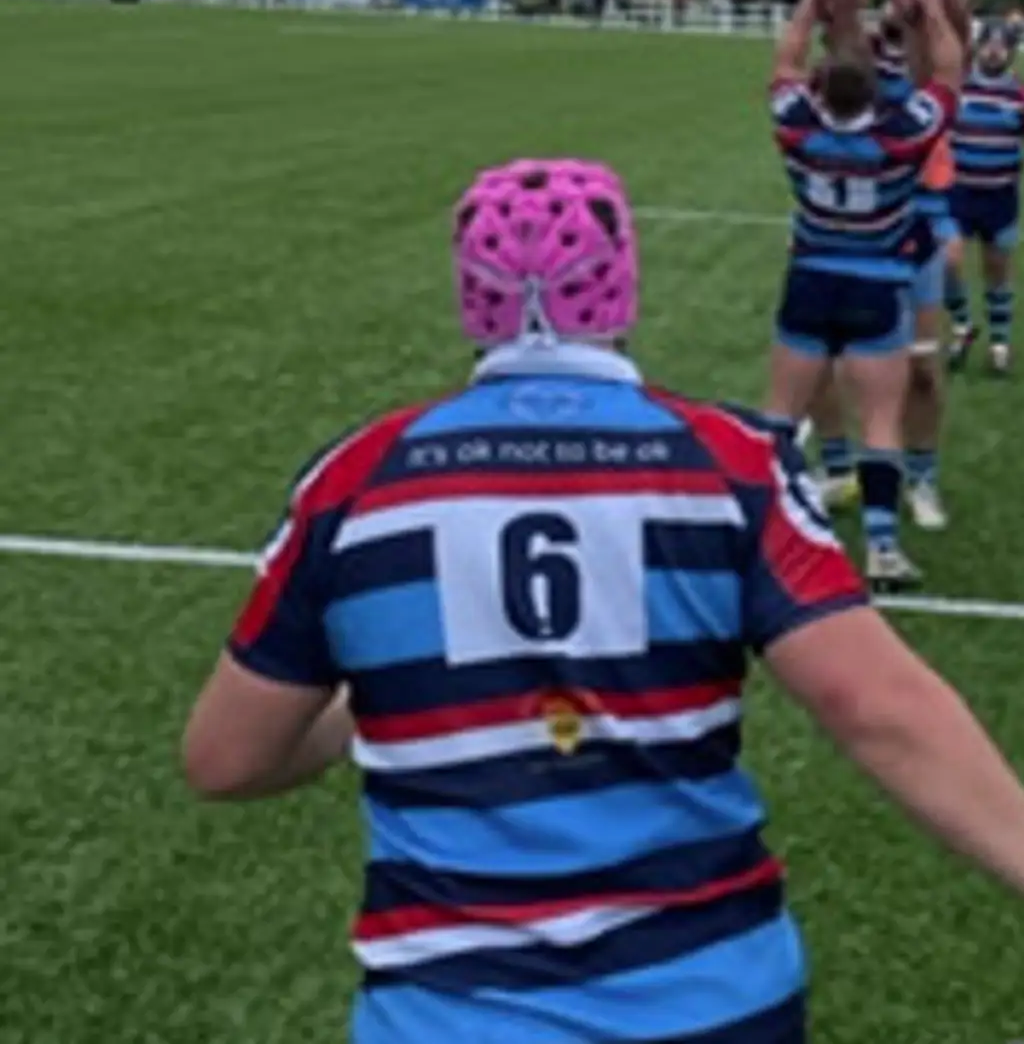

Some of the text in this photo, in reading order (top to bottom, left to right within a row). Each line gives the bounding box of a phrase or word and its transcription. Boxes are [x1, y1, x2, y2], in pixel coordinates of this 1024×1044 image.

[456, 437, 491, 463] ok
[498, 439, 550, 463] not
[553, 440, 586, 462] to
[592, 438, 629, 462] be
[637, 438, 671, 462] ok
[501, 511, 580, 642] 6
